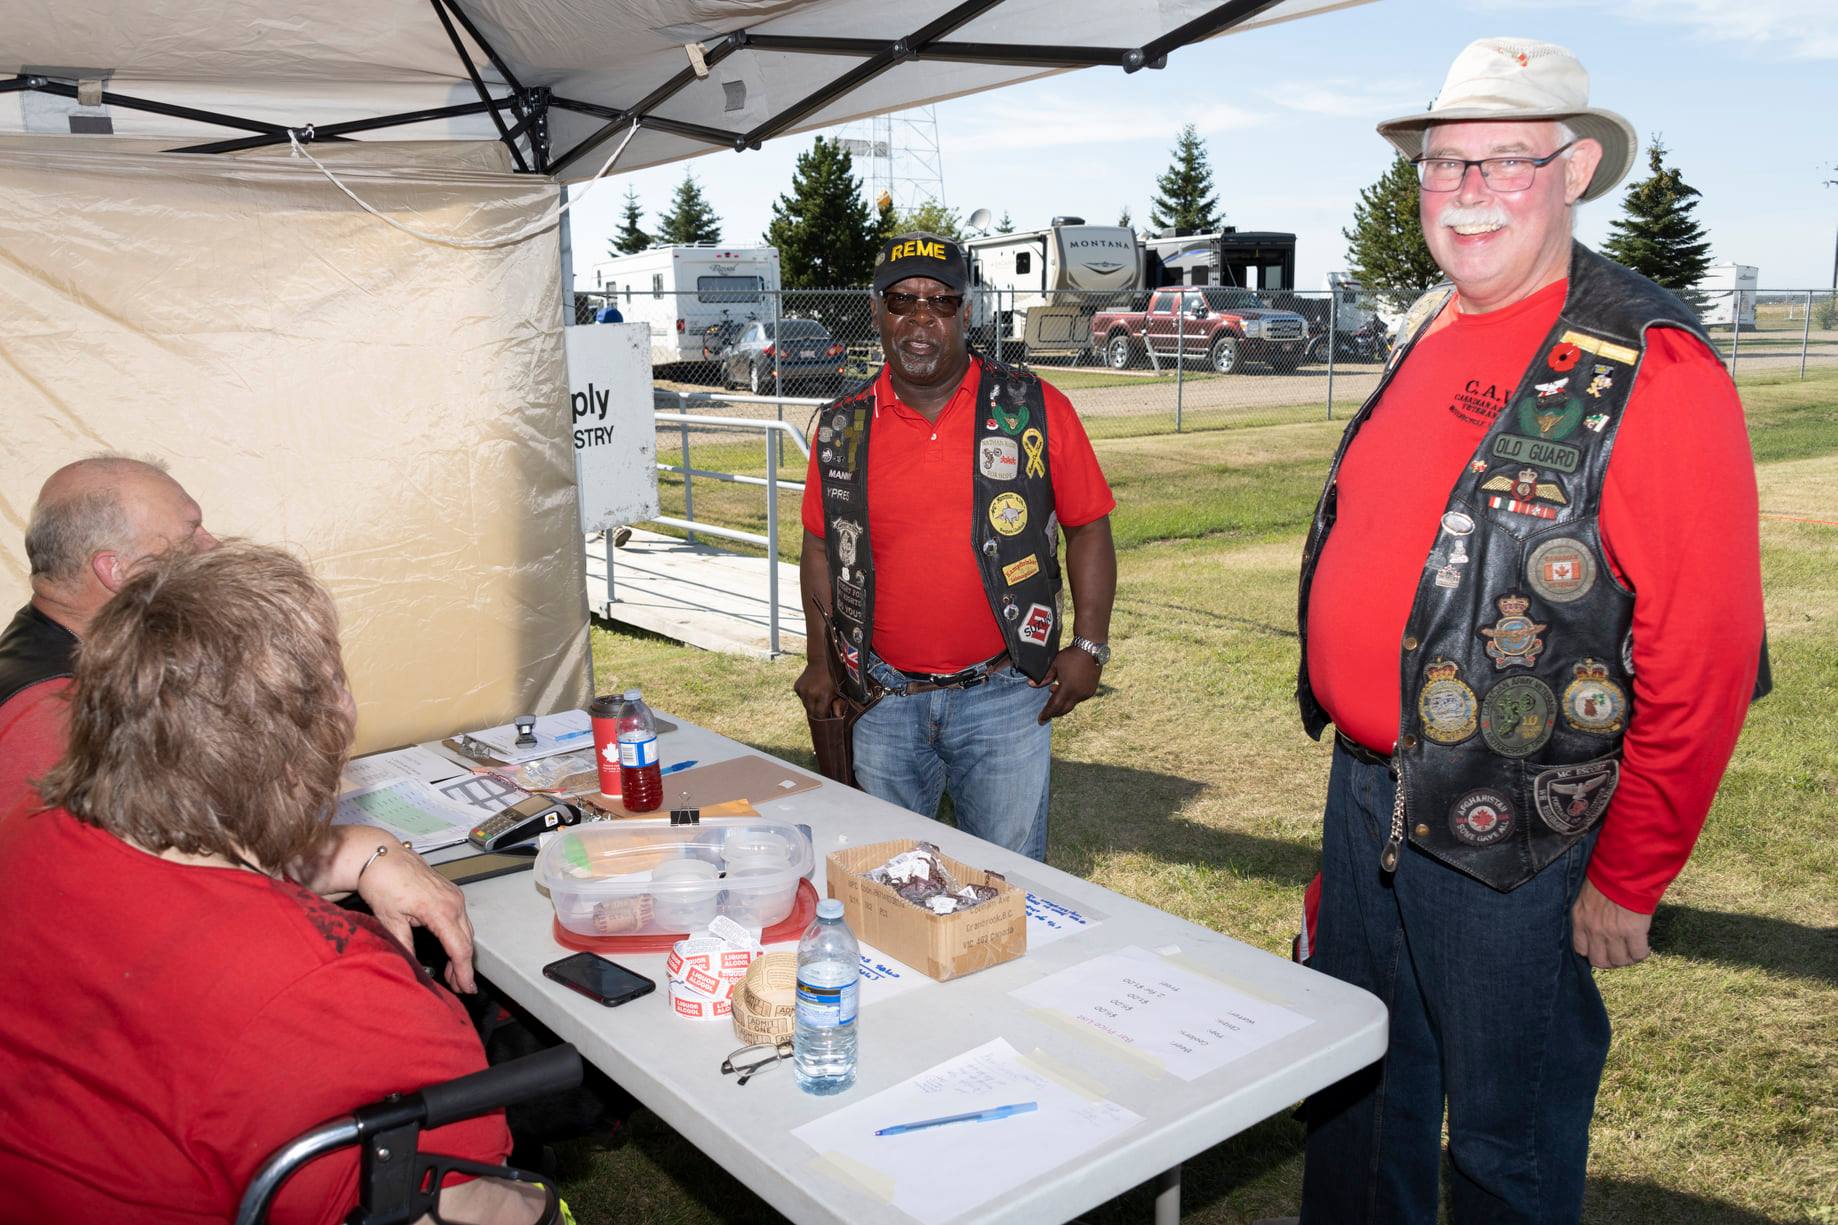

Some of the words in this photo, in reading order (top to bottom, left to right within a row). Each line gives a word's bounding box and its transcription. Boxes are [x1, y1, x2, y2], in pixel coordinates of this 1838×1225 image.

[890, 239, 947, 262] REME
[1069, 240, 1130, 250] MONTANA
[571, 383, 610, 424] ply
[574, 425, 614, 449] STRY
[1496, 438, 1522, 456] OLD
[1529, 444, 1576, 467] GUARD
[827, 487, 850, 501] YPRES
[1457, 794, 1508, 816] AFGHANISTAN
[1456, 823, 1476, 841] SOME
[1477, 831, 1500, 842] GAVE
[689, 976, 713, 991] ALCOOL
[692, 969, 716, 986] LIQUOR
[677, 1000, 698, 1008] LIQUOR
[677, 1007, 699, 1015] ALCOOL
[751, 1018, 773, 1027] ADMIT
[754, 1025, 771, 1034] ONE
